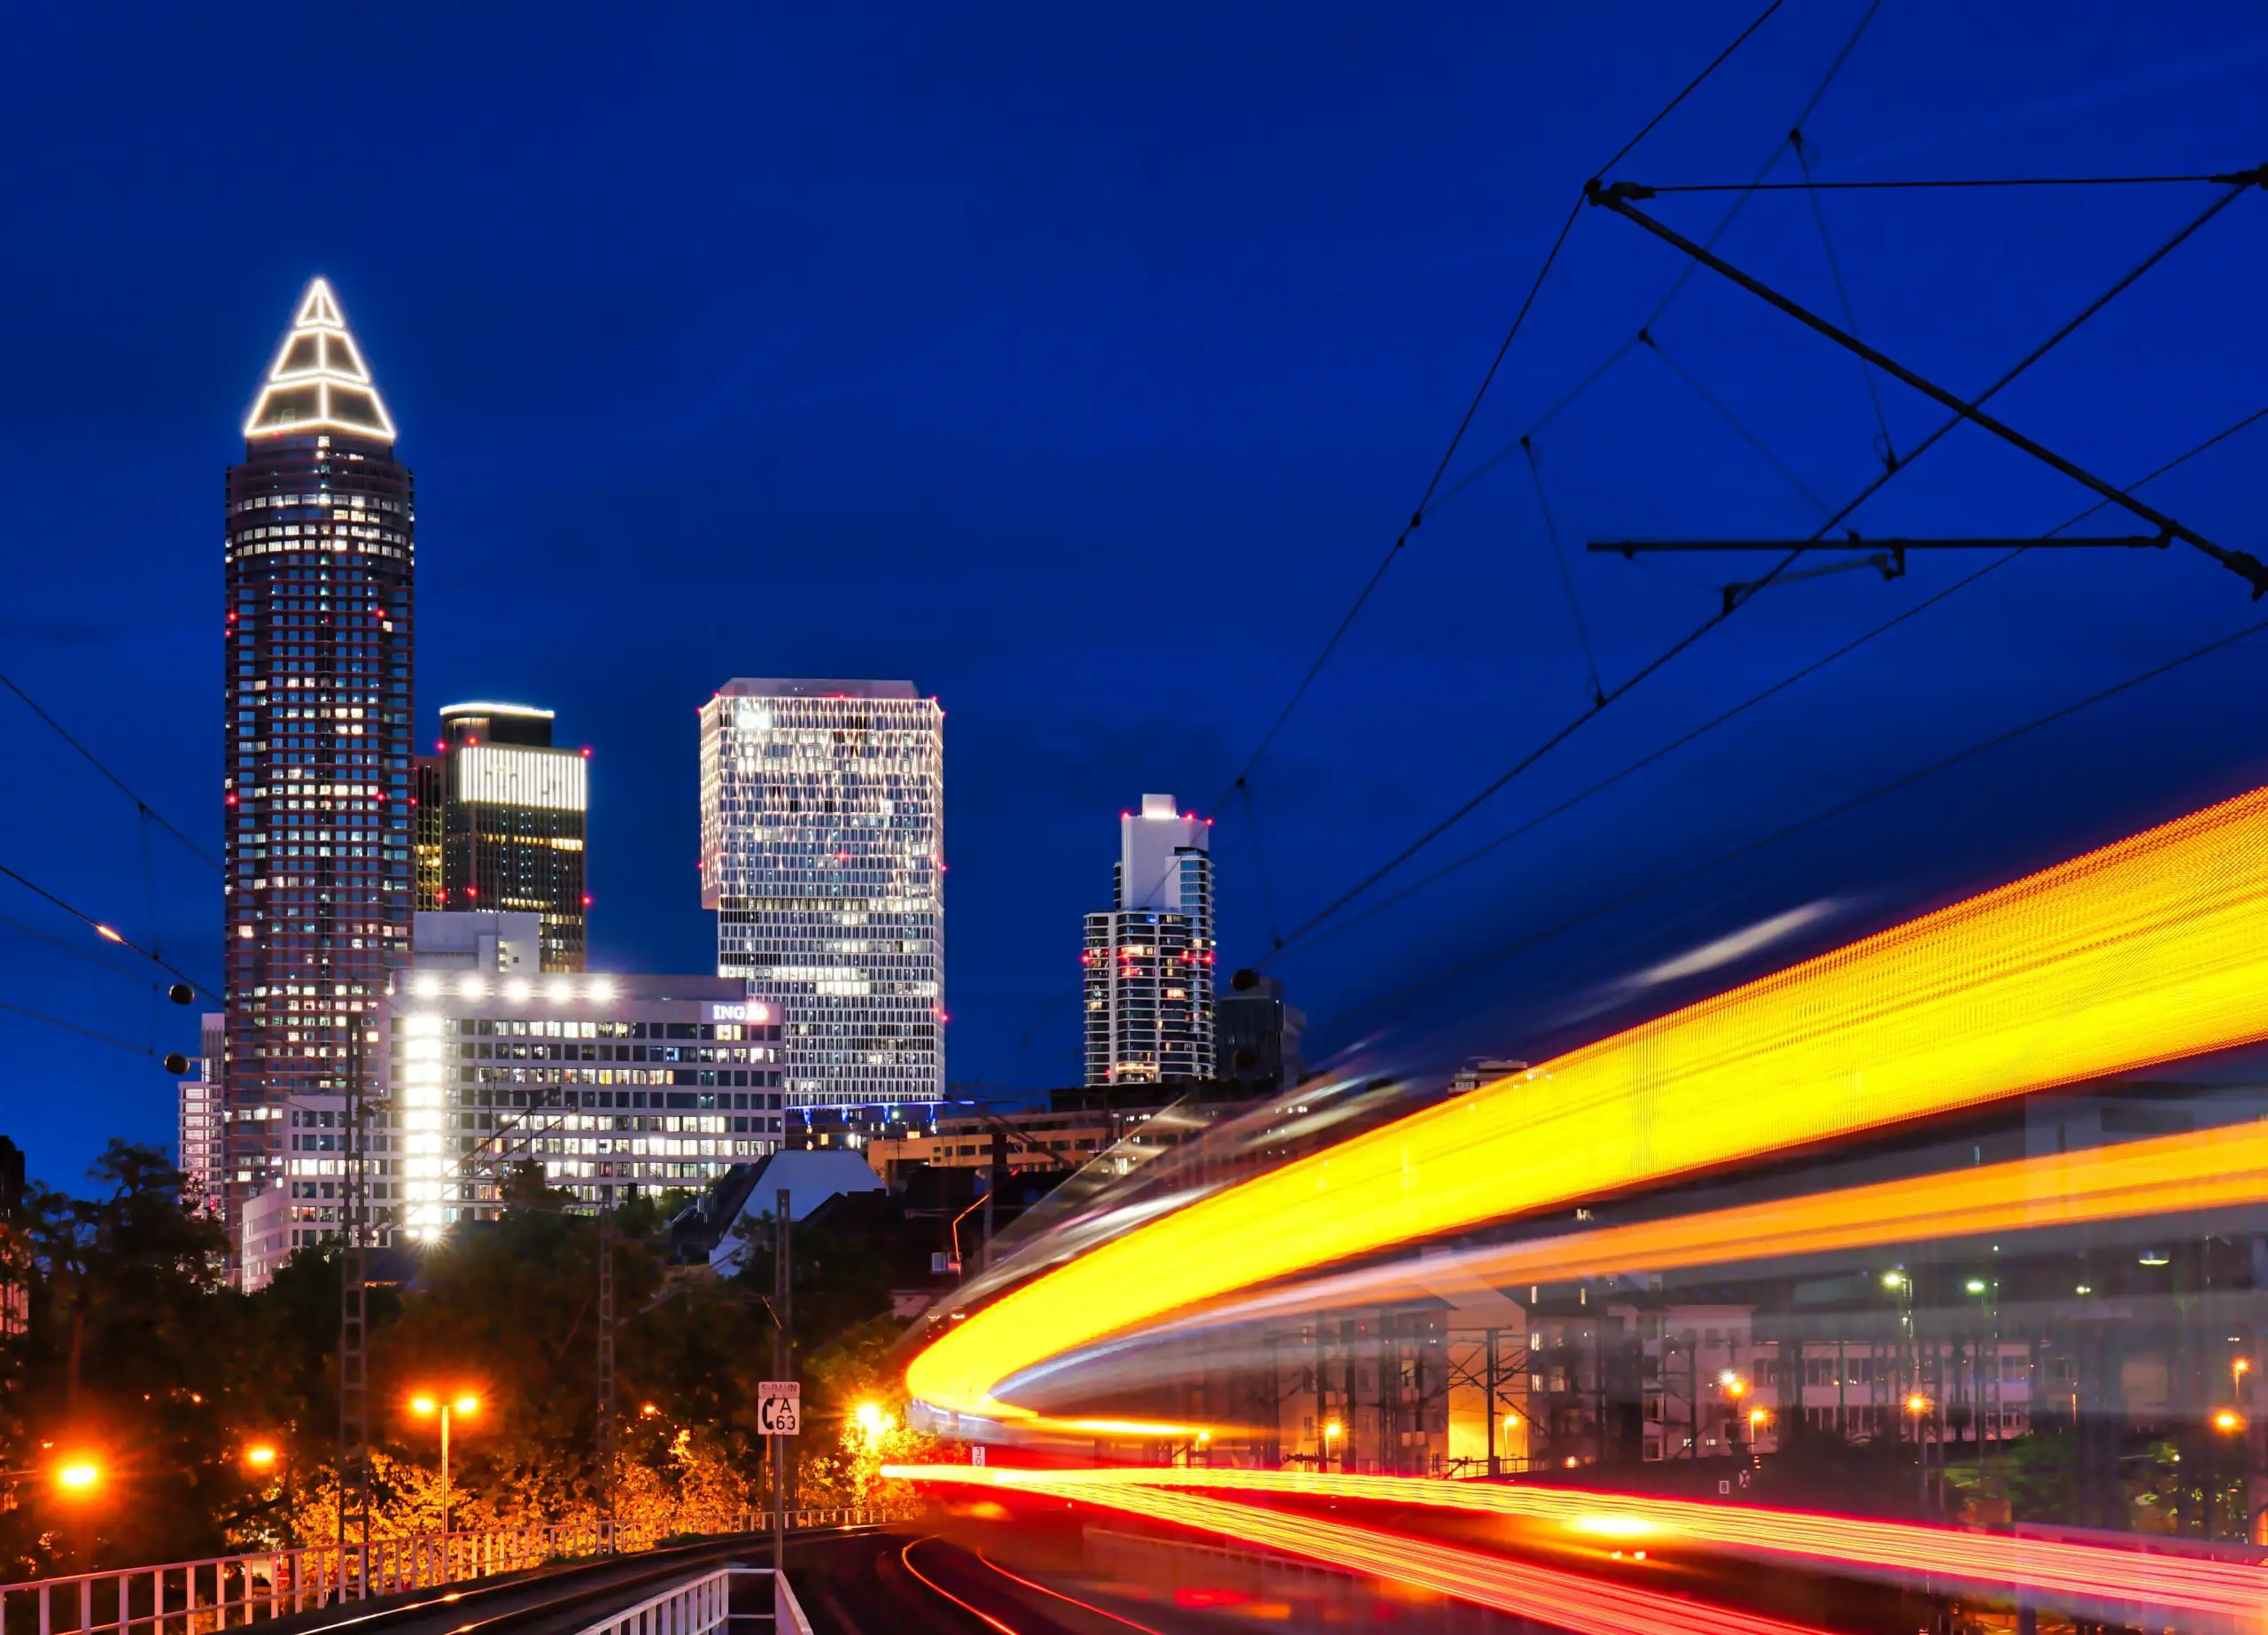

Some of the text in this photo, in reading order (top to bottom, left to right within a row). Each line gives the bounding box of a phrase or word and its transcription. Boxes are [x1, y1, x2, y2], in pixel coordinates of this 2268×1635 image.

[712, 1004, 745, 1020] ING
[780, 1398, 792, 1414] A
[776, 1415, 796, 1430] 63
